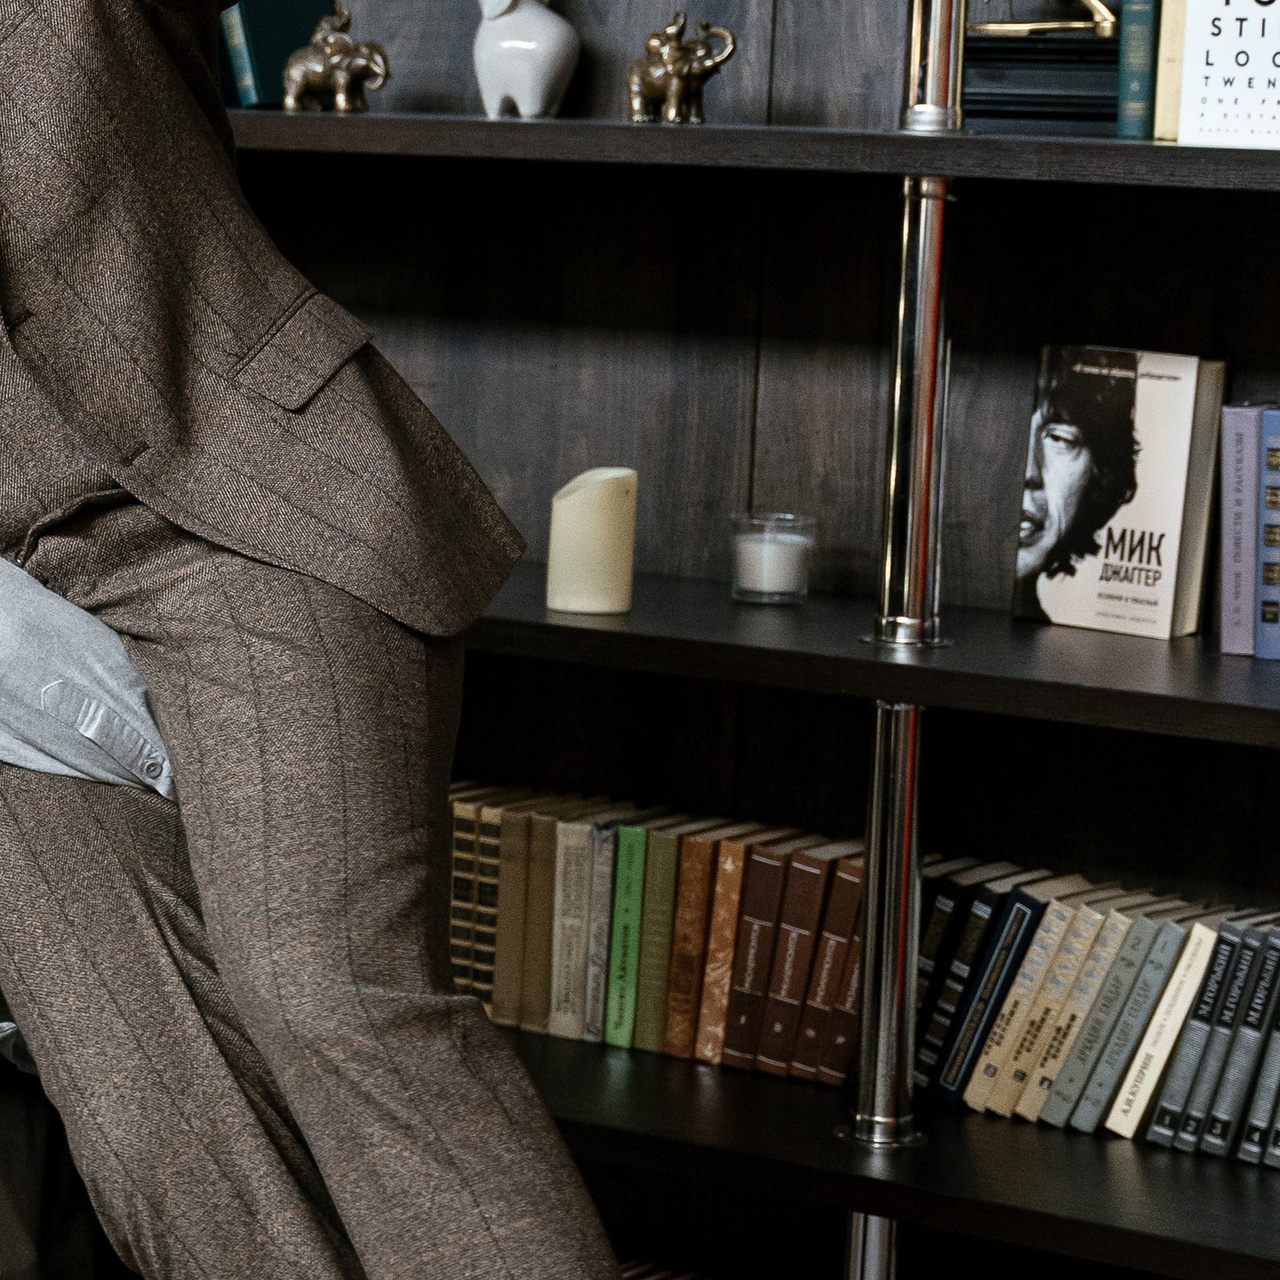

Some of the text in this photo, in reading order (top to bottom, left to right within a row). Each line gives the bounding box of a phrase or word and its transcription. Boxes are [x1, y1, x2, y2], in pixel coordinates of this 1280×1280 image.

[1210, 17, 1266, 38] STI
[1203, 76, 1277, 89] TWEN
[1104, 526, 1166, 567] МИК
[1097, 563, 1162, 588] ДЖАГГЕР
[1199, 944, 1229, 1016] М.ГОРЬКИЙ
[1223, 950, 1252, 1022] М.ГОРЬКИЙ
[1248, 950, 1278, 1024] М.ГОРЬКИЙ
